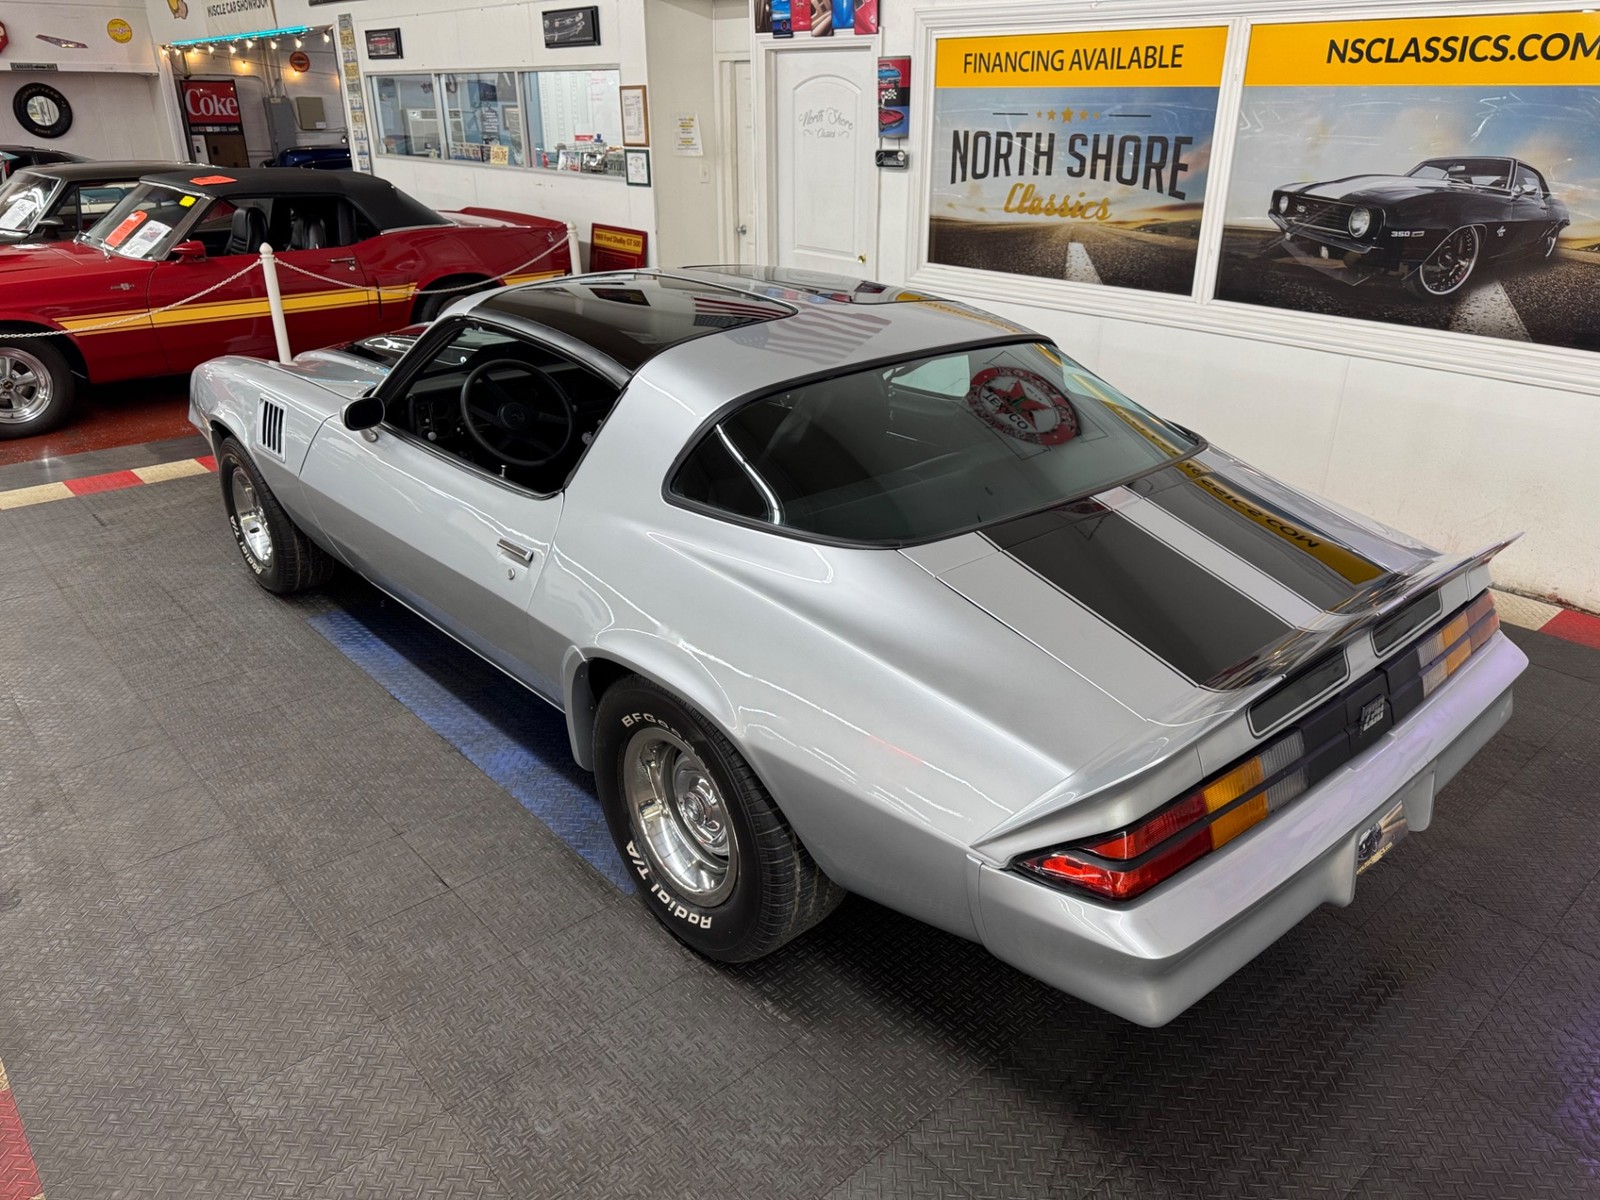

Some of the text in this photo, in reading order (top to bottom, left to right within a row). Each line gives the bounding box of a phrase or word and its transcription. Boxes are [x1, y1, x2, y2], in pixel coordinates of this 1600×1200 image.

[207, 4, 226, 17] MUSCLE
[226, 1, 237, 14] CAR
[963, 44, 1184, 74] FINANCING AVAILABLE
[1326, 32, 1600, 64] NSCLASSICS.COM
[185, 88, 239, 116] Coke
[798, 106, 853, 130] North Shore
[950, 130, 1193, 201] NORTH SHORE
[1003, 183, 1112, 221] Classics
[1391, 230, 1410, 238] 350
[626, 840, 649, 880] T/A
[650, 883, 713, 929] Radial
